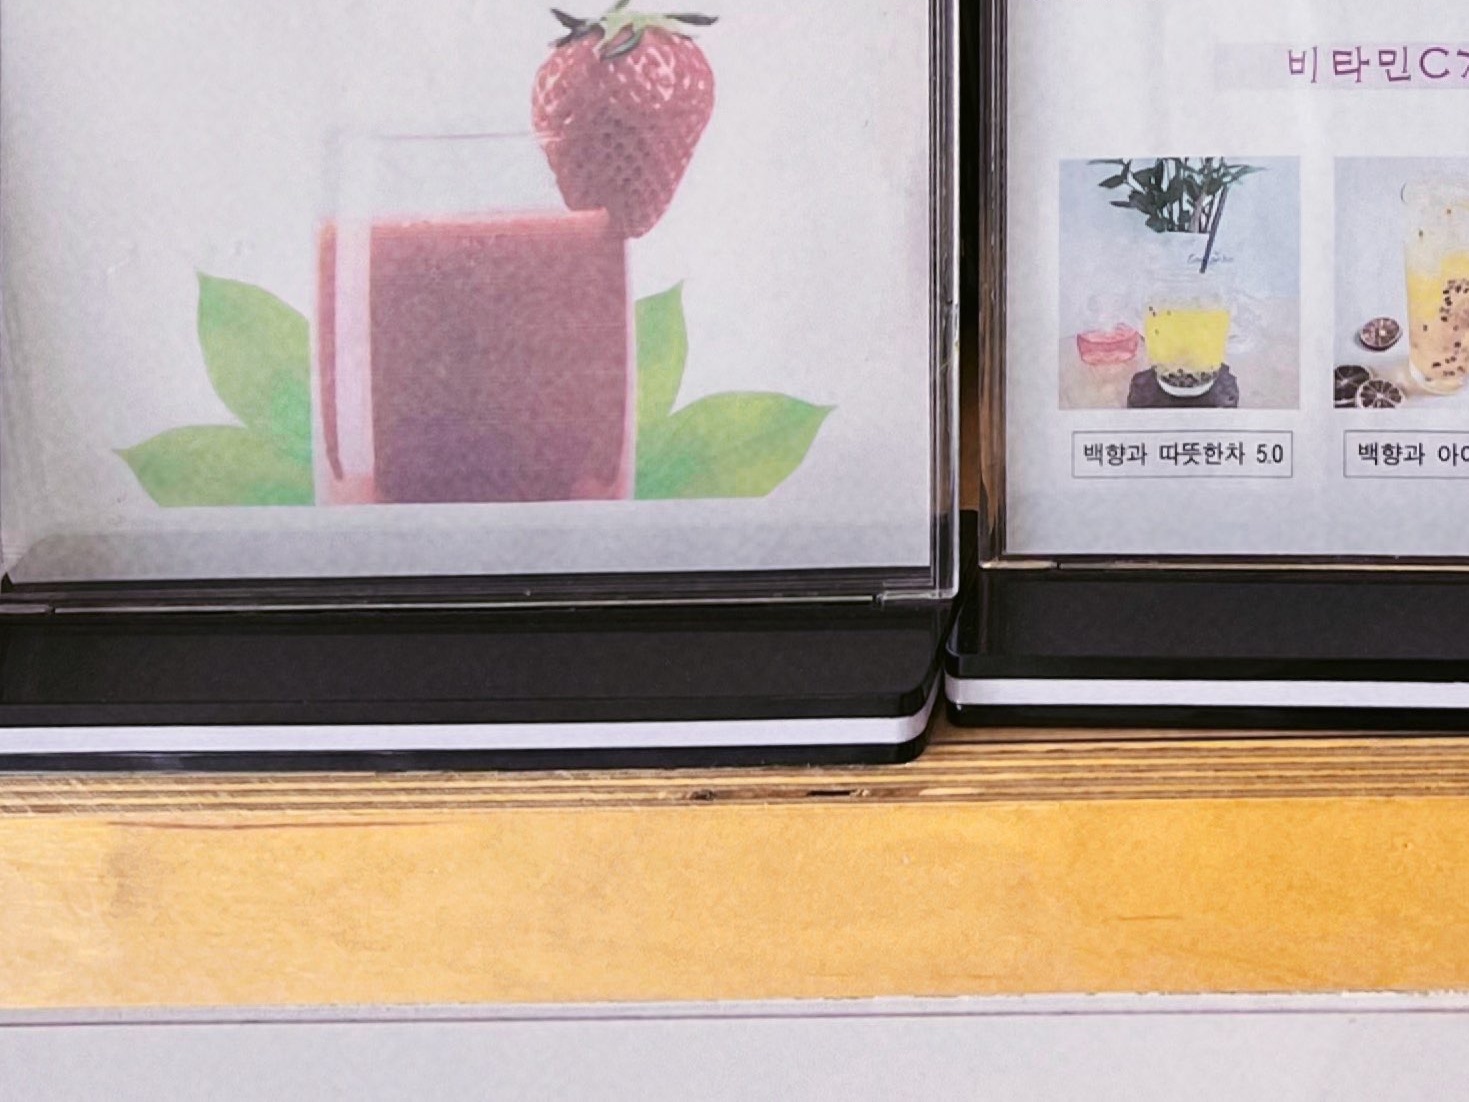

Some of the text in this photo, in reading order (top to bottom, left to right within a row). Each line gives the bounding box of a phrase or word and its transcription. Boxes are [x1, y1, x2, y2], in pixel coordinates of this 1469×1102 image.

[1083, 442, 1284, 467] 백향과 따뜻한차 5.0
[1357, 442, 1425, 466] 백향과
